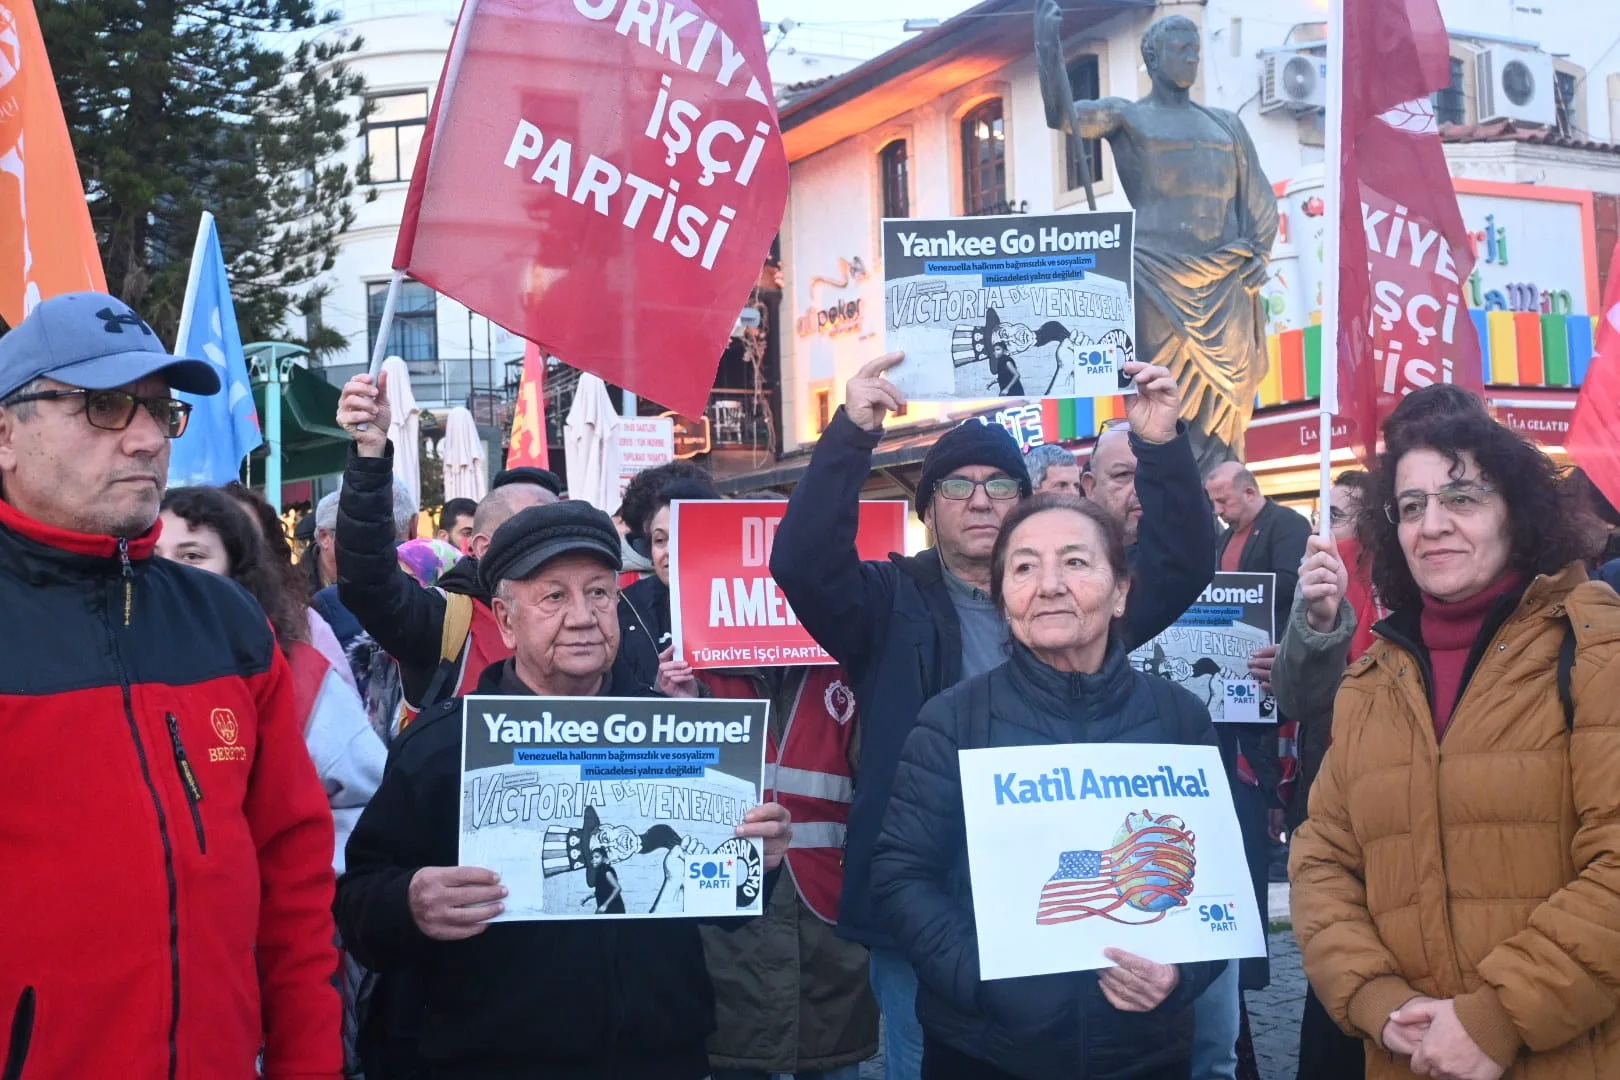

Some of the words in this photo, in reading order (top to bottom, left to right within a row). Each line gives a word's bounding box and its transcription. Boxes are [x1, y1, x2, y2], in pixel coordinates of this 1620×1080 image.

[644, 73, 771, 187] İŞÇİ
[503, 118, 736, 271] PARTİSİ
[897, 230, 996, 258] Yankee
[1000, 231, 1035, 255] Go
[1039, 224, 1120, 252] Home!
[1360, 201, 1459, 285] KİYE
[1467, 214, 1508, 266] rji
[1057, 257, 1092, 267] sosyalizm
[986, 272, 1030, 282] mücadelesi
[1009, 284, 1029, 304] DE
[1469, 268, 1572, 314] tamin
[1368, 262, 1459, 346] ŞÇİ
[1078, 351, 1112, 367] SOL
[1373, 339, 1454, 397] İSİ
[692, 646, 751, 661] TÜRKİYE
[753, 645, 780, 661] İŞÇİ
[782, 643, 831, 658] PARTİS
[1226, 684, 1254, 697] SOL
[482, 711, 599, 743] Yankee
[603, 715, 646, 743] Go
[652, 714, 752, 743] Home!
[518, 751, 567, 760] Venezuella
[569, 751, 606, 760] halkının
[608, 751, 659, 762] bağımsızlık
[671, 750, 715, 761] sosyalizm
[585, 766, 636, 776] mücadelesi
[637, 766, 664, 777] yalnız
[665, 765, 702, 776] değildir!
[611, 780, 636, 802] DE
[994, 767, 1076, 805] Katil
[1080, 765, 1210, 800] Amerika!
[689, 861, 730, 879] SOL
[1199, 903, 1234, 922] SOL
